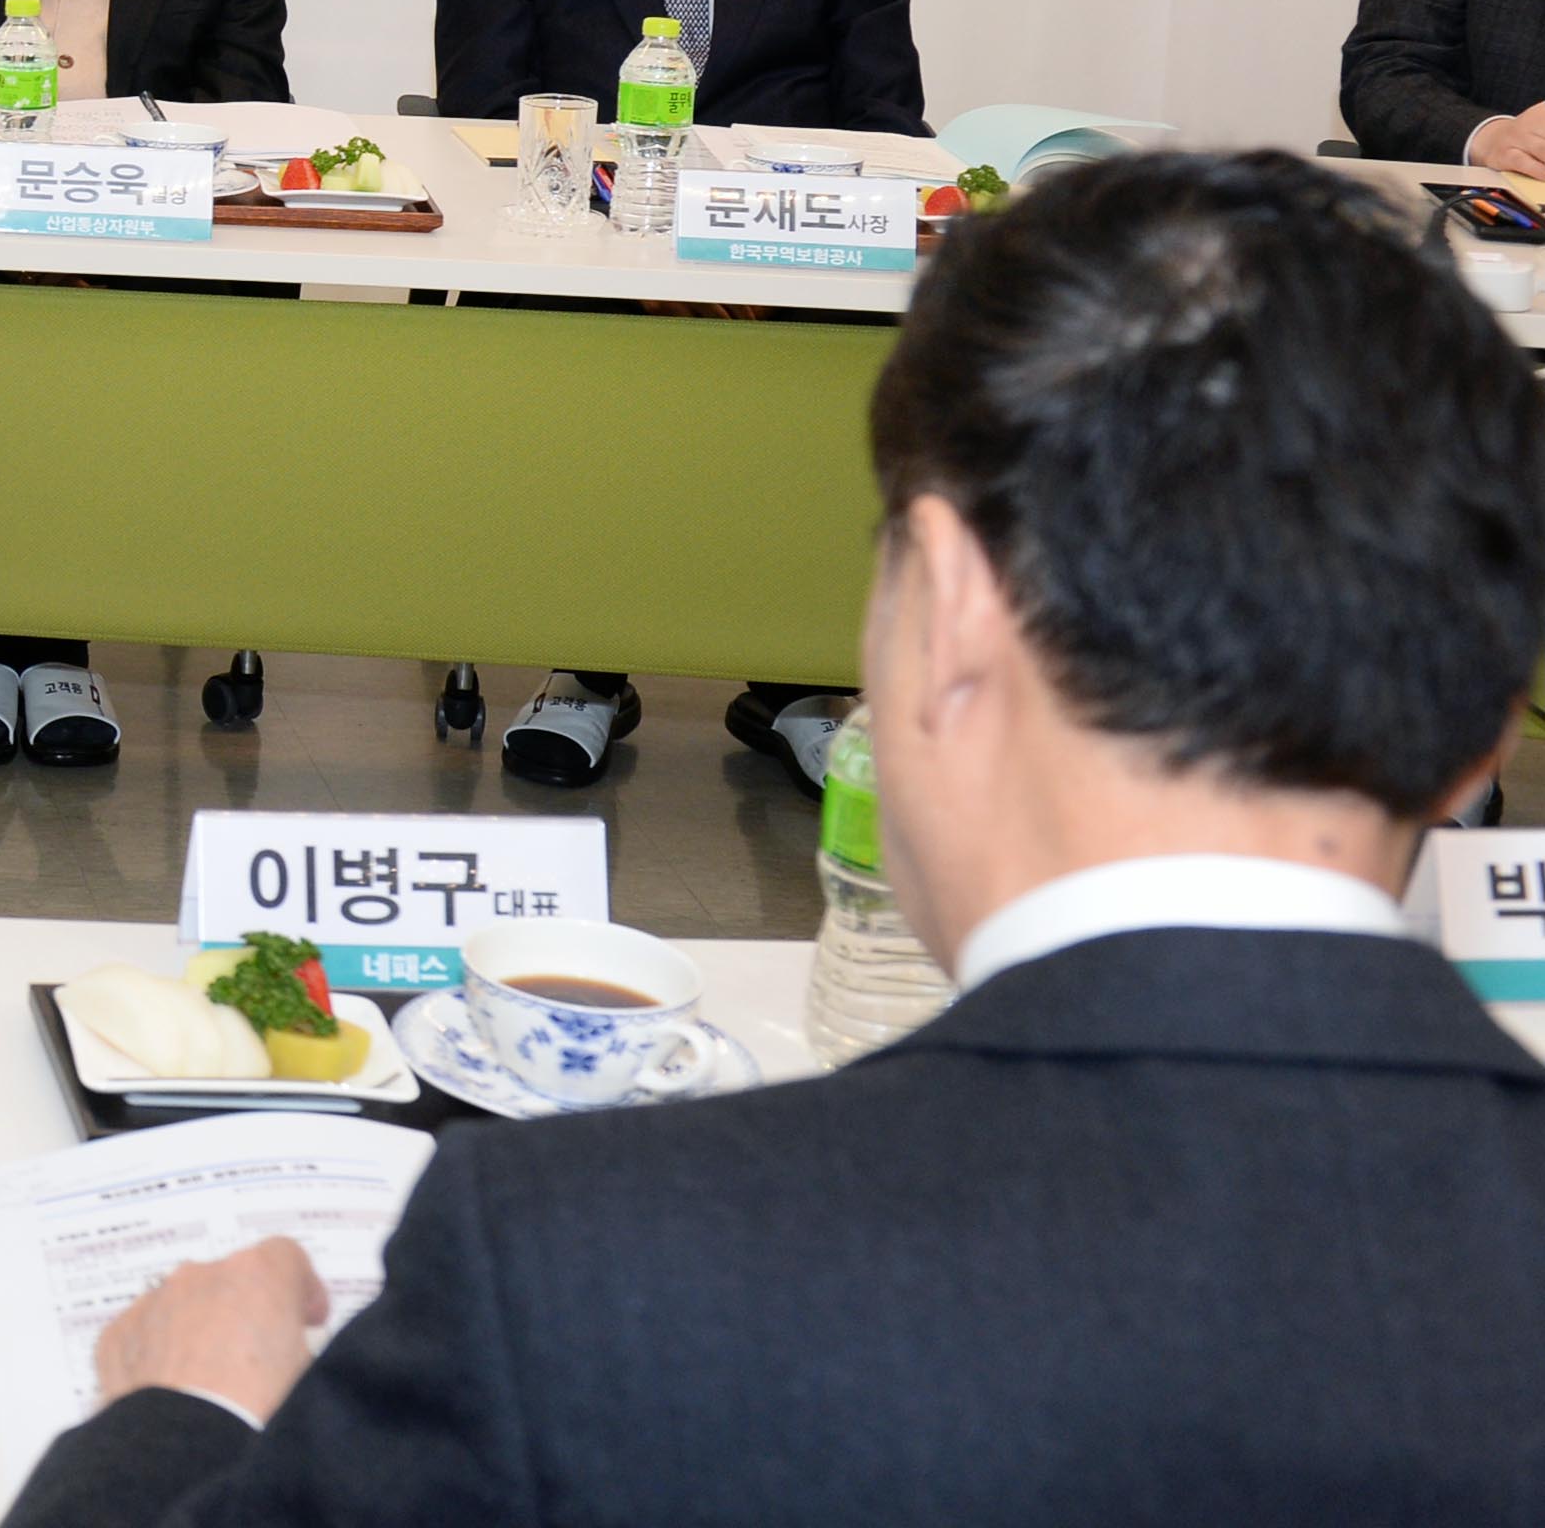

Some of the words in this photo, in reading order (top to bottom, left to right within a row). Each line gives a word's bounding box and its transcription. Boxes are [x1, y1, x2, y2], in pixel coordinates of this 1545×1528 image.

[16, 159, 149, 206] 문승욱
[45, 214, 156, 237] 산업통상자원부
[704, 186, 846, 233] 문재도
[847, 213, 890, 235] 사장
[728, 242, 864, 266] 한국무역보험공사
[44, 680, 84, 695] 고객용
[249, 845, 488, 927] 이병구
[493, 890, 560, 918] 대표
[362, 952, 450, 984] 네패스
